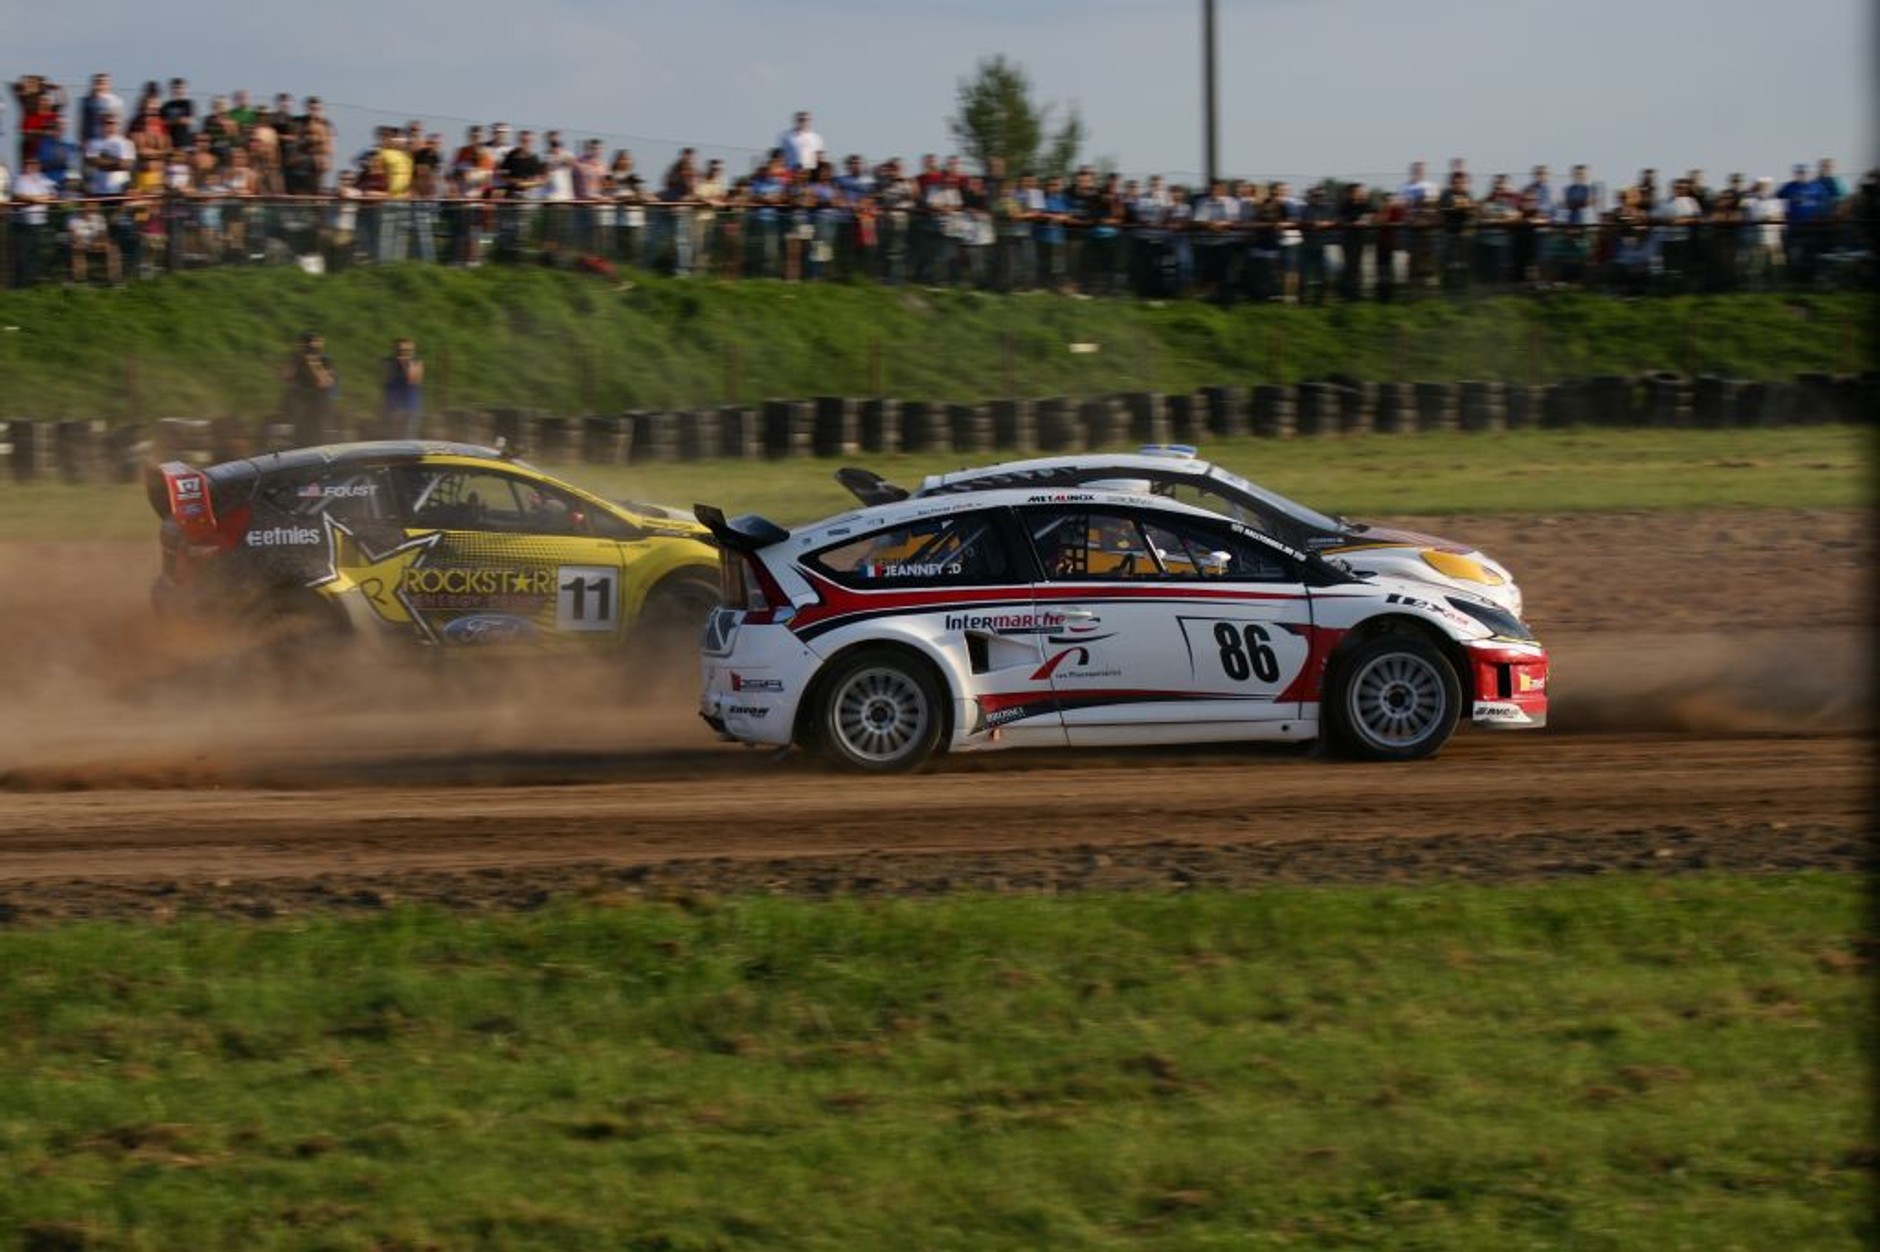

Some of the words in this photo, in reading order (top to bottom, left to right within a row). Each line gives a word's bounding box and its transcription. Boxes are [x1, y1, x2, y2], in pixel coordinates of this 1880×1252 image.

[884, 563, 943, 577] JEANNEY
[560, 576, 610, 620] 11
[1213, 622, 1280, 683] 86
